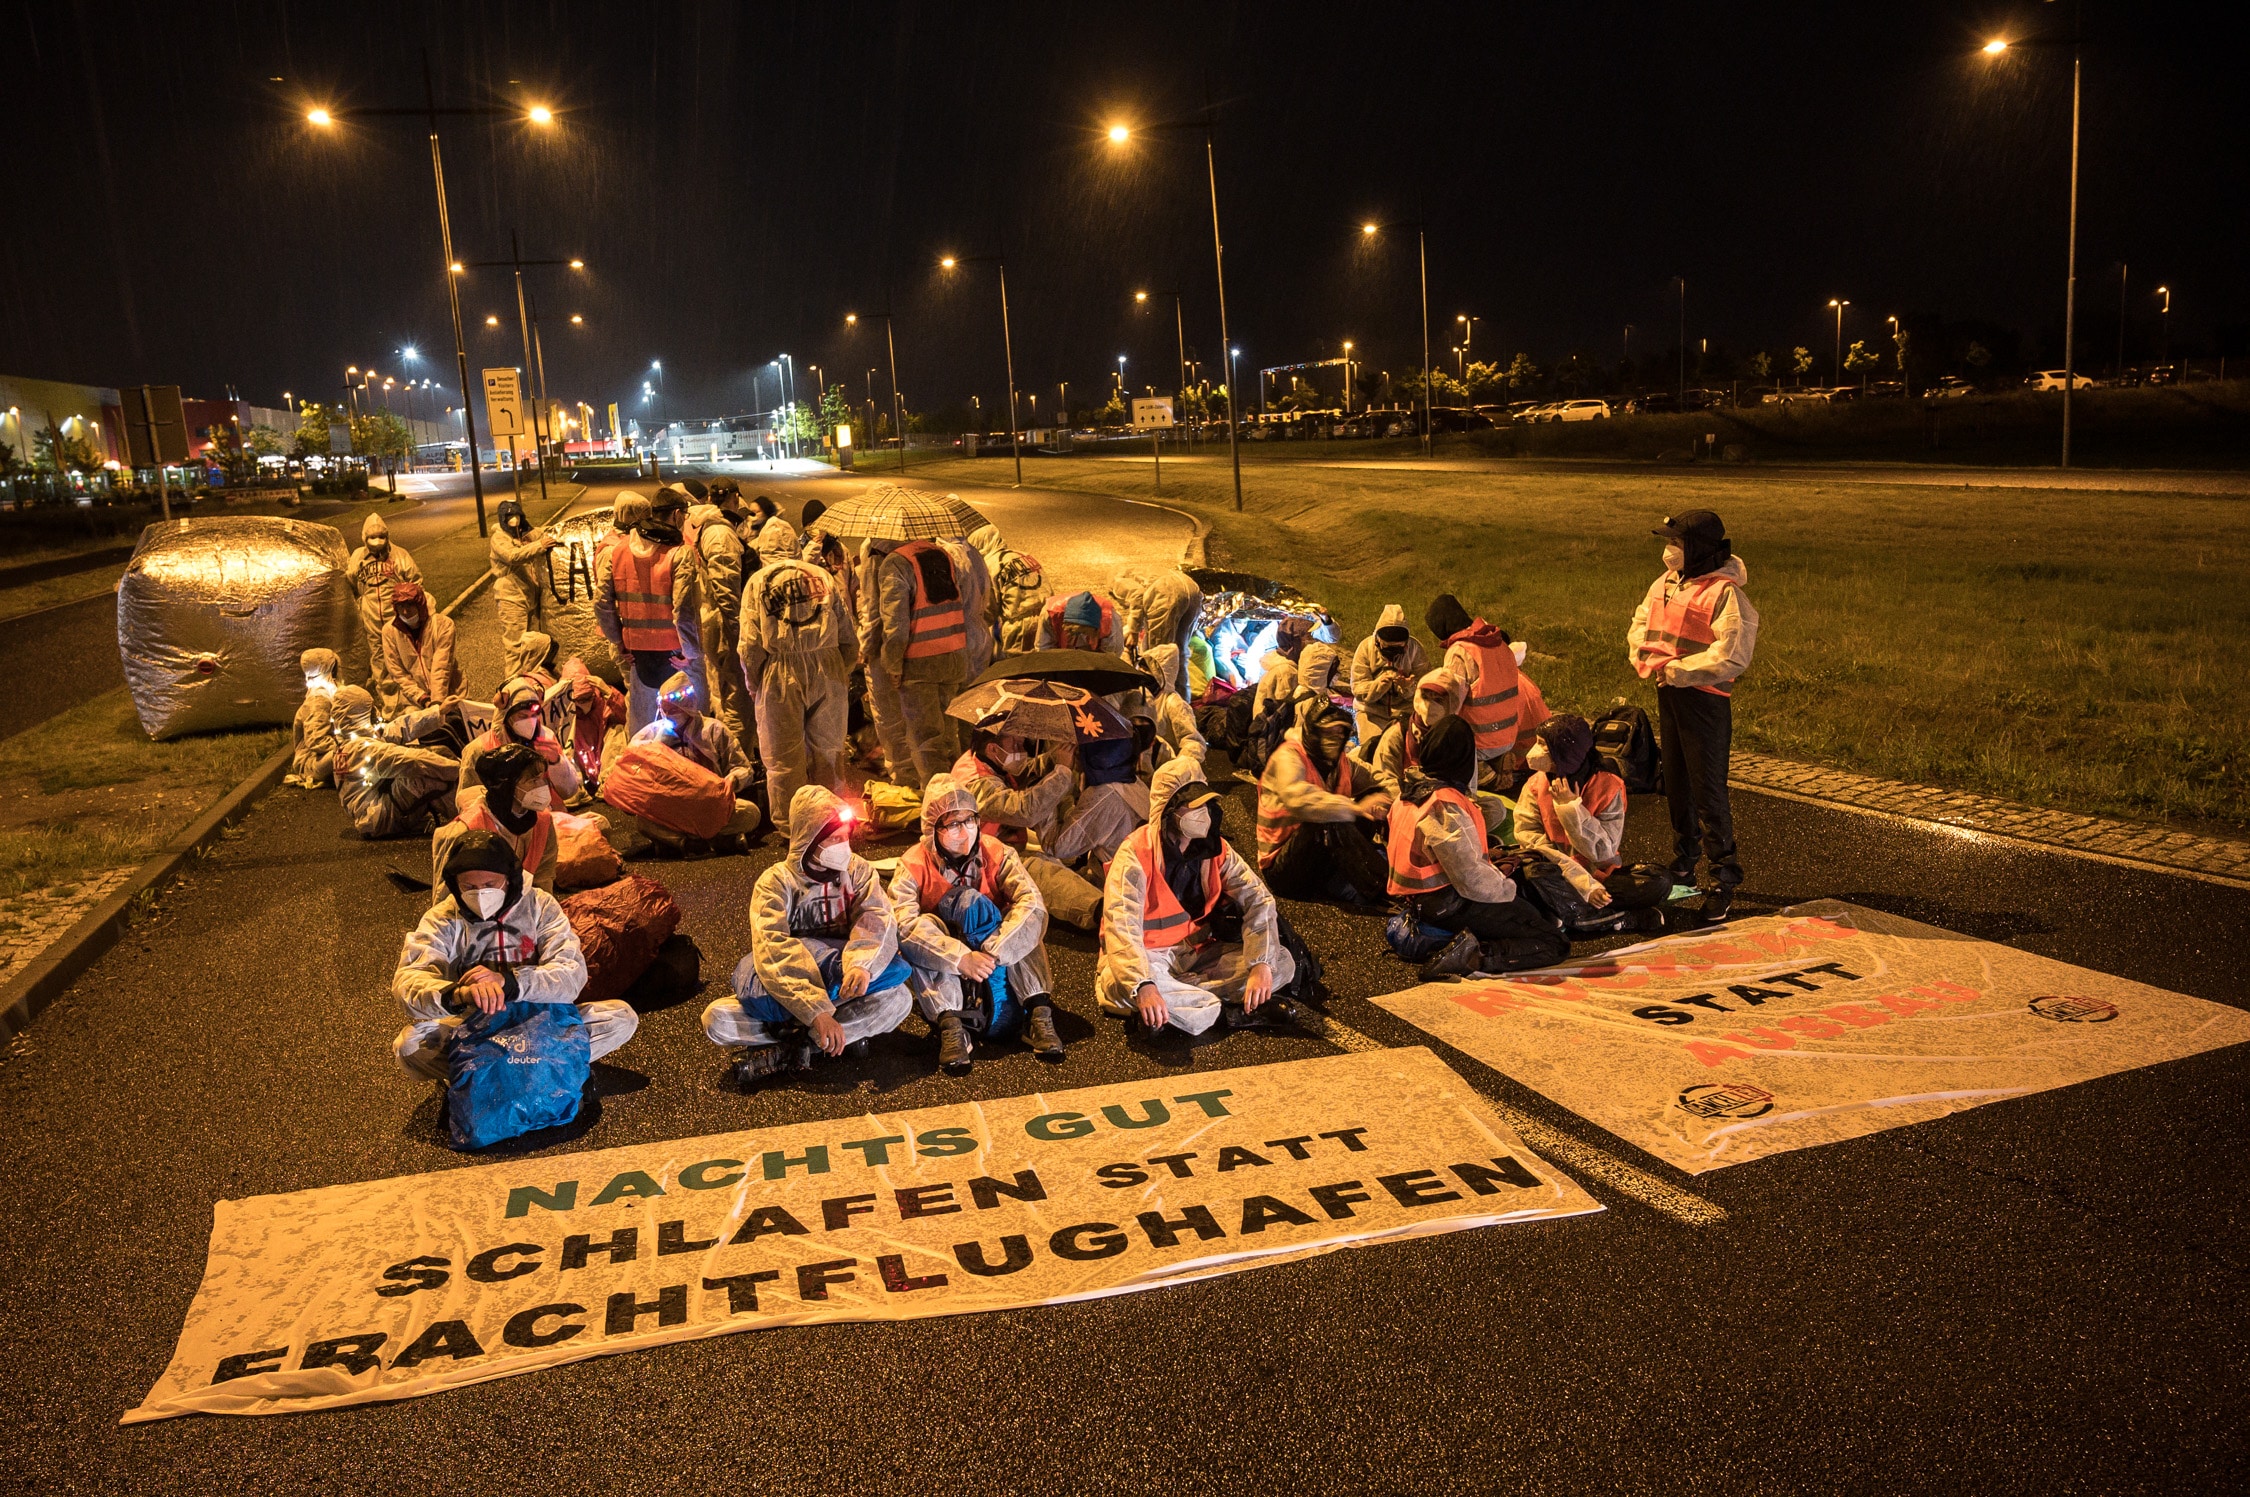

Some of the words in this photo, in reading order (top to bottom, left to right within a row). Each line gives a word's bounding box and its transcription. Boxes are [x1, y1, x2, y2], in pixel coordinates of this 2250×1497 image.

[1632, 962, 1863, 1026] STATT
[1682, 980, 1982, 1068] AUSBAU
[507, 1055, 541, 1064] deuter
[504, 1127, 979, 1219] NACHTS
[1025, 1088, 1234, 1141] GUT
[375, 1168, 1048, 1298] SCHLAFEN
[1099, 1127, 1368, 1189] STATT
[211, 1155, 1544, 1385] FRACHTFLUGHAFEN
